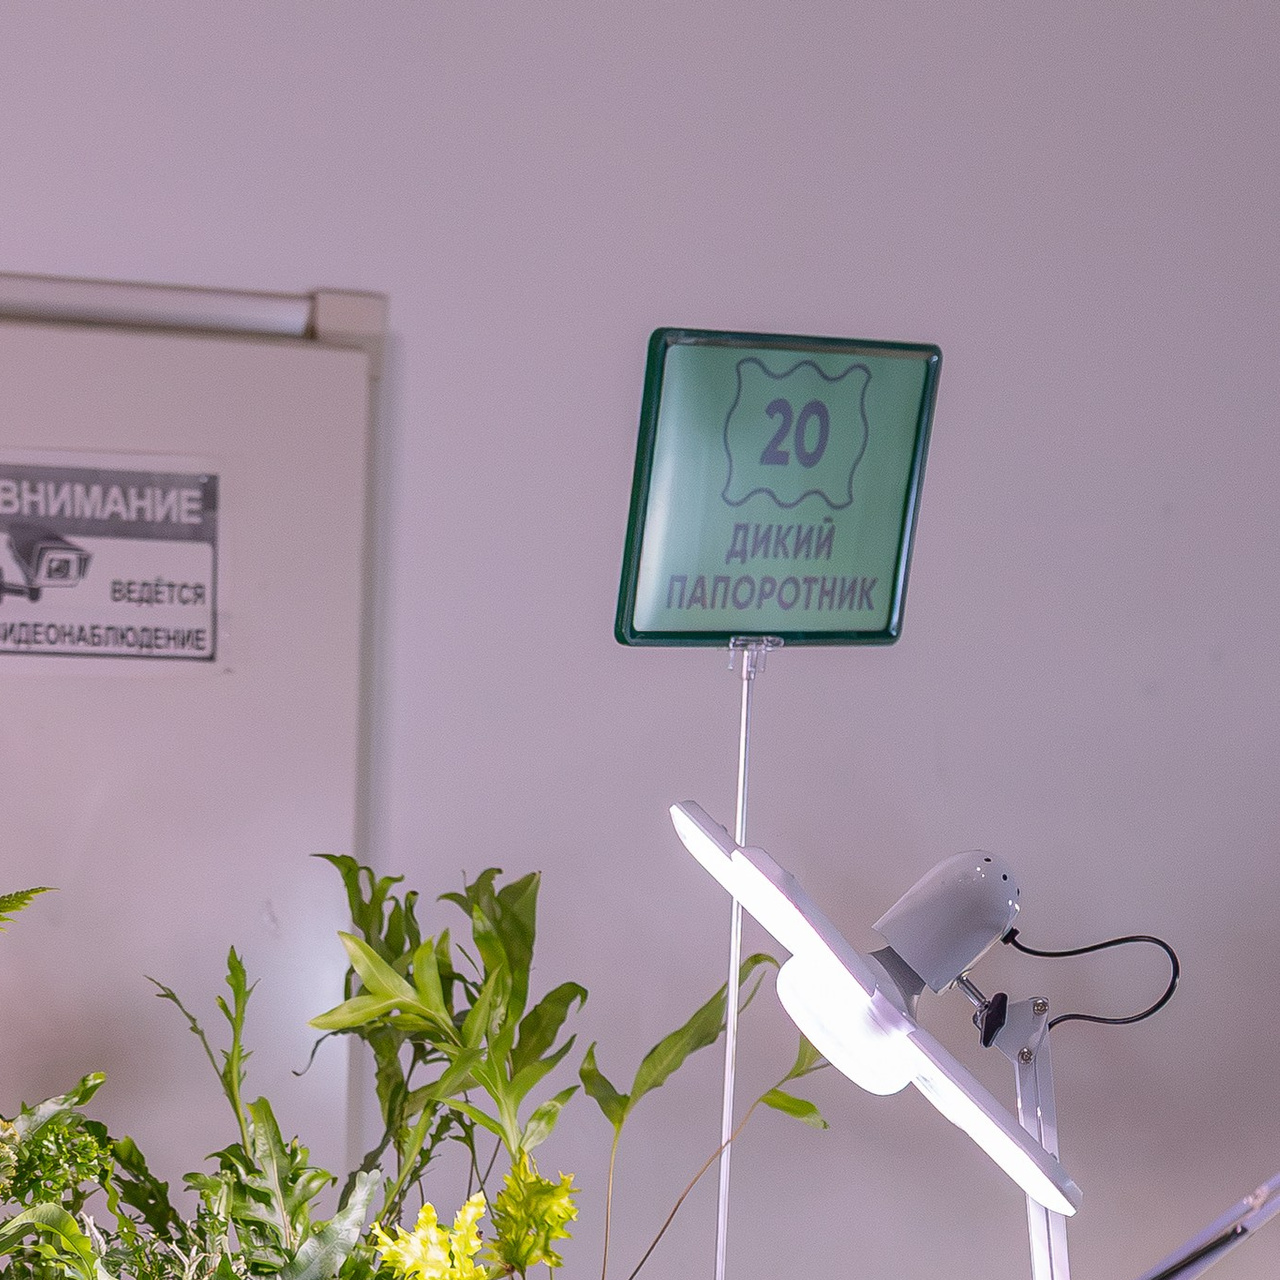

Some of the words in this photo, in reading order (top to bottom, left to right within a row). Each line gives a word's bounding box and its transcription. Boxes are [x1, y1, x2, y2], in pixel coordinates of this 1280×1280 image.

[758, 397, 831, 469] 20
[724, 516, 837, 565] ДИКИЙ
[110, 576, 207, 606] ВЕДЁТСЯ
[665, 574, 879, 612] ПАПОРОТНИК
